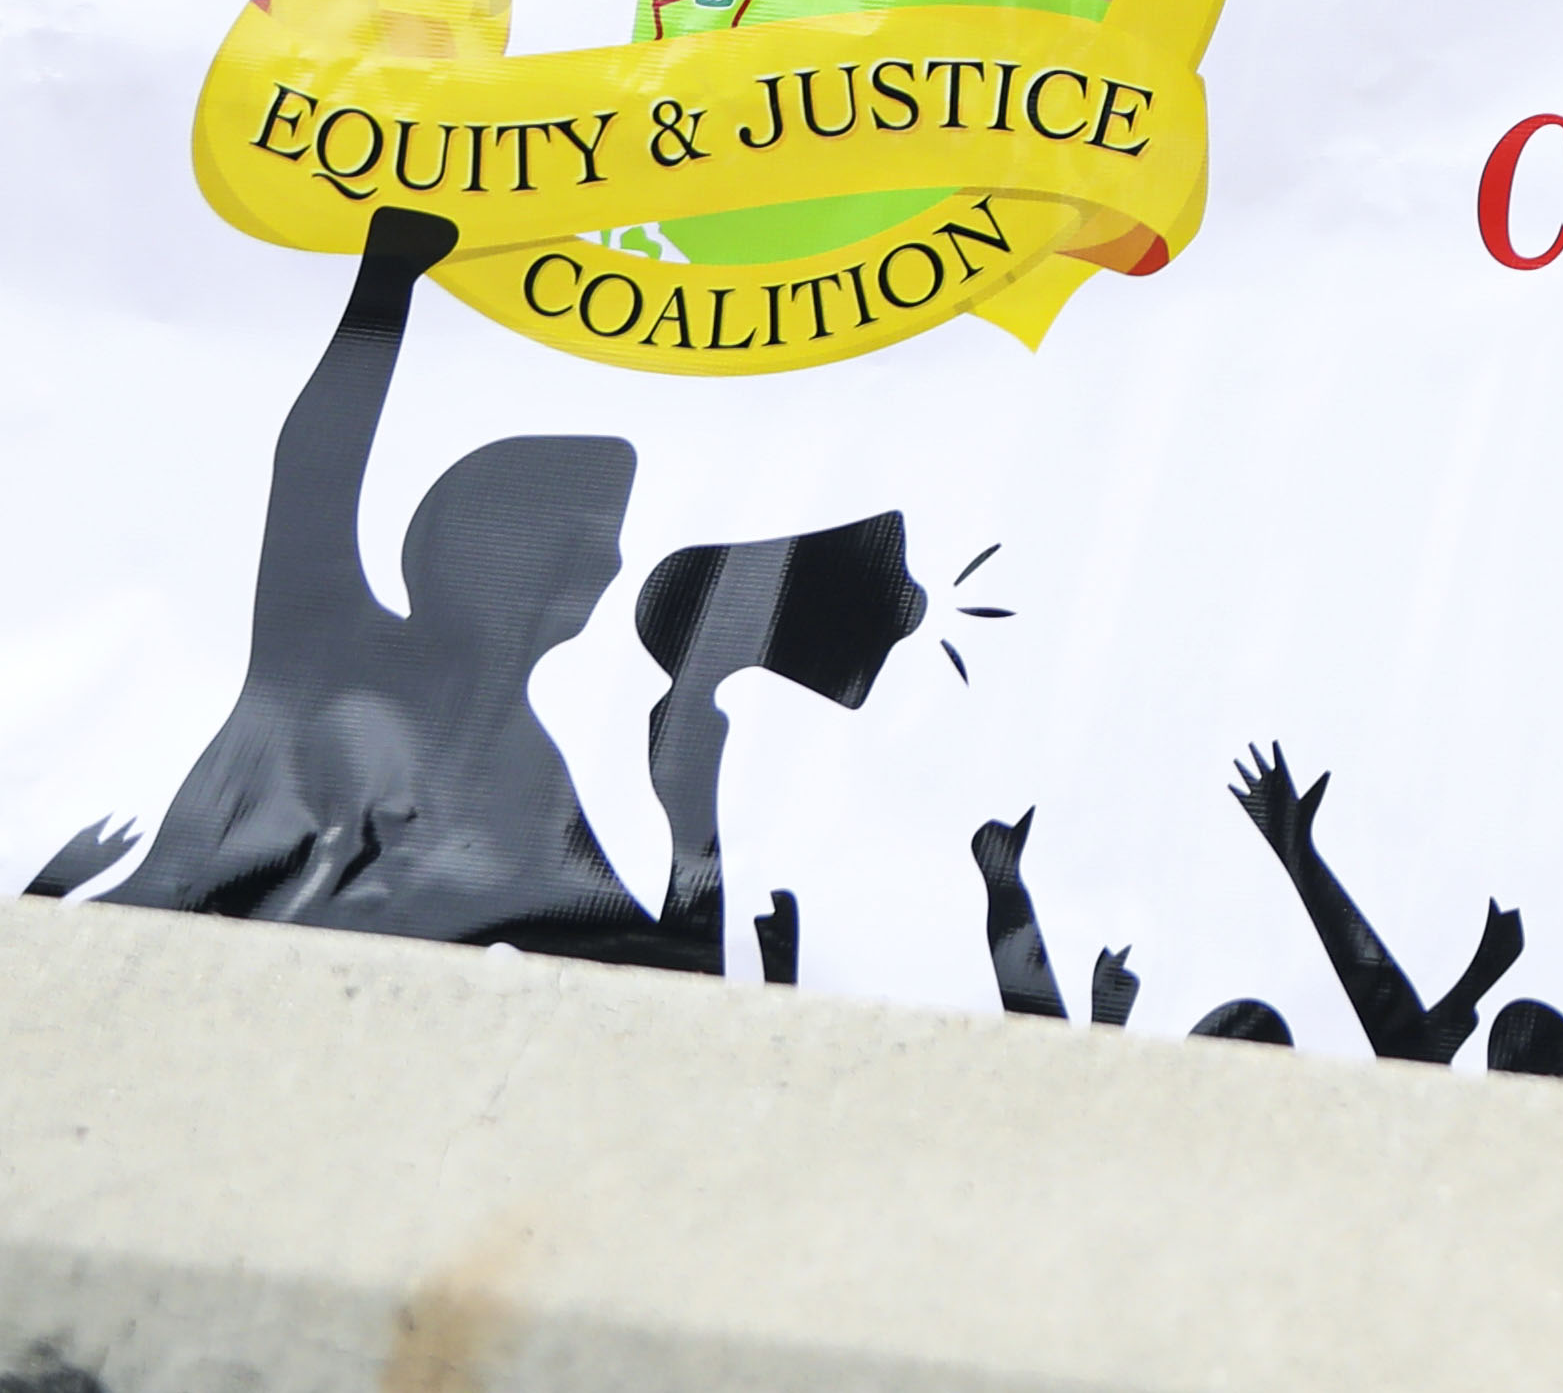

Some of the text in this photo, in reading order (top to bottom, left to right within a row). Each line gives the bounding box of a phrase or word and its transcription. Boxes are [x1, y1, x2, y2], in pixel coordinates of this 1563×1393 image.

[251, 59, 1157, 201] EQUITY & JUSTICE
[520, 198, 1017, 354] COALITION
